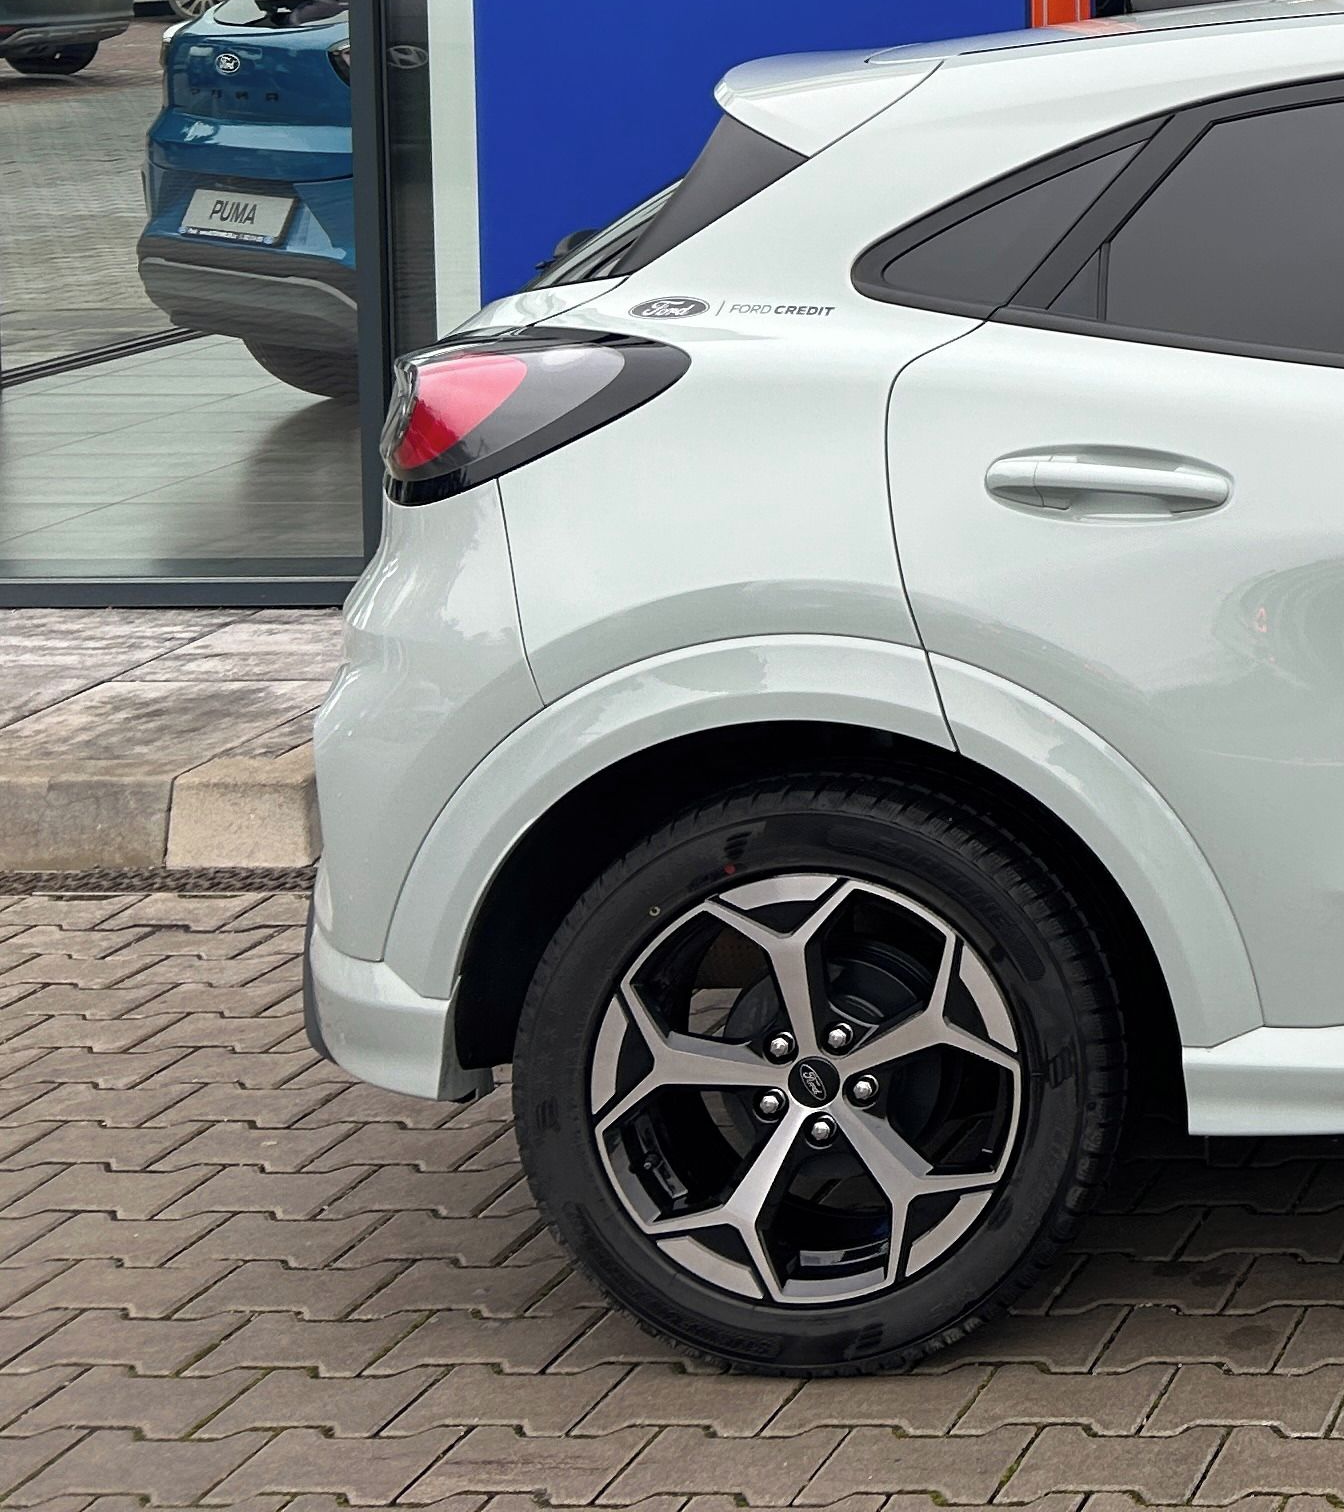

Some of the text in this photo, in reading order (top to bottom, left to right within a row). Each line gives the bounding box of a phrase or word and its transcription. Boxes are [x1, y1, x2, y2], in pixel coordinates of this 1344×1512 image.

[209, 199, 258, 225] PUMA
[642, 300, 695, 317] Ford
[729, 304, 836, 316] FORD CREDIT
